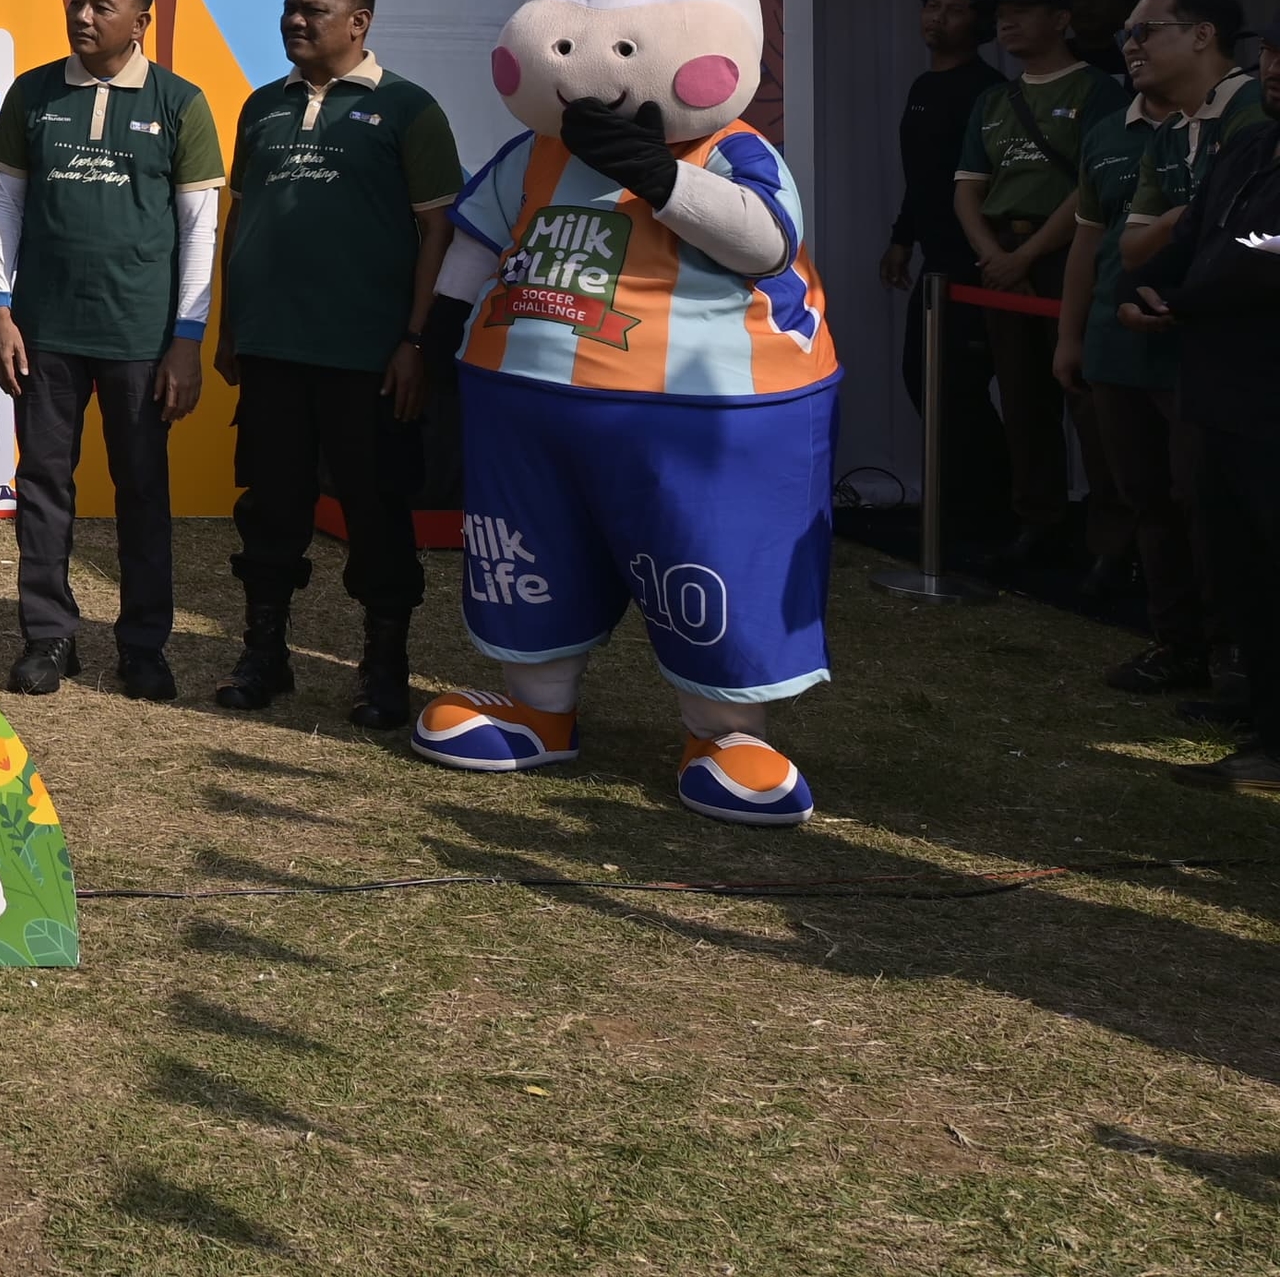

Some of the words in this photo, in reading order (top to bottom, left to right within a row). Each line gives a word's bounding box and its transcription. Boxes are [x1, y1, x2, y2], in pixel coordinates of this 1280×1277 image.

[526, 213, 614, 260] Milk
[528, 250, 609, 294] Life
[513, 301, 588, 322] CHALLENGE
[522, 289, 575, 307] SOCCER
[467, 559, 553, 605] Life
[630, 553, 727, 646] 10
